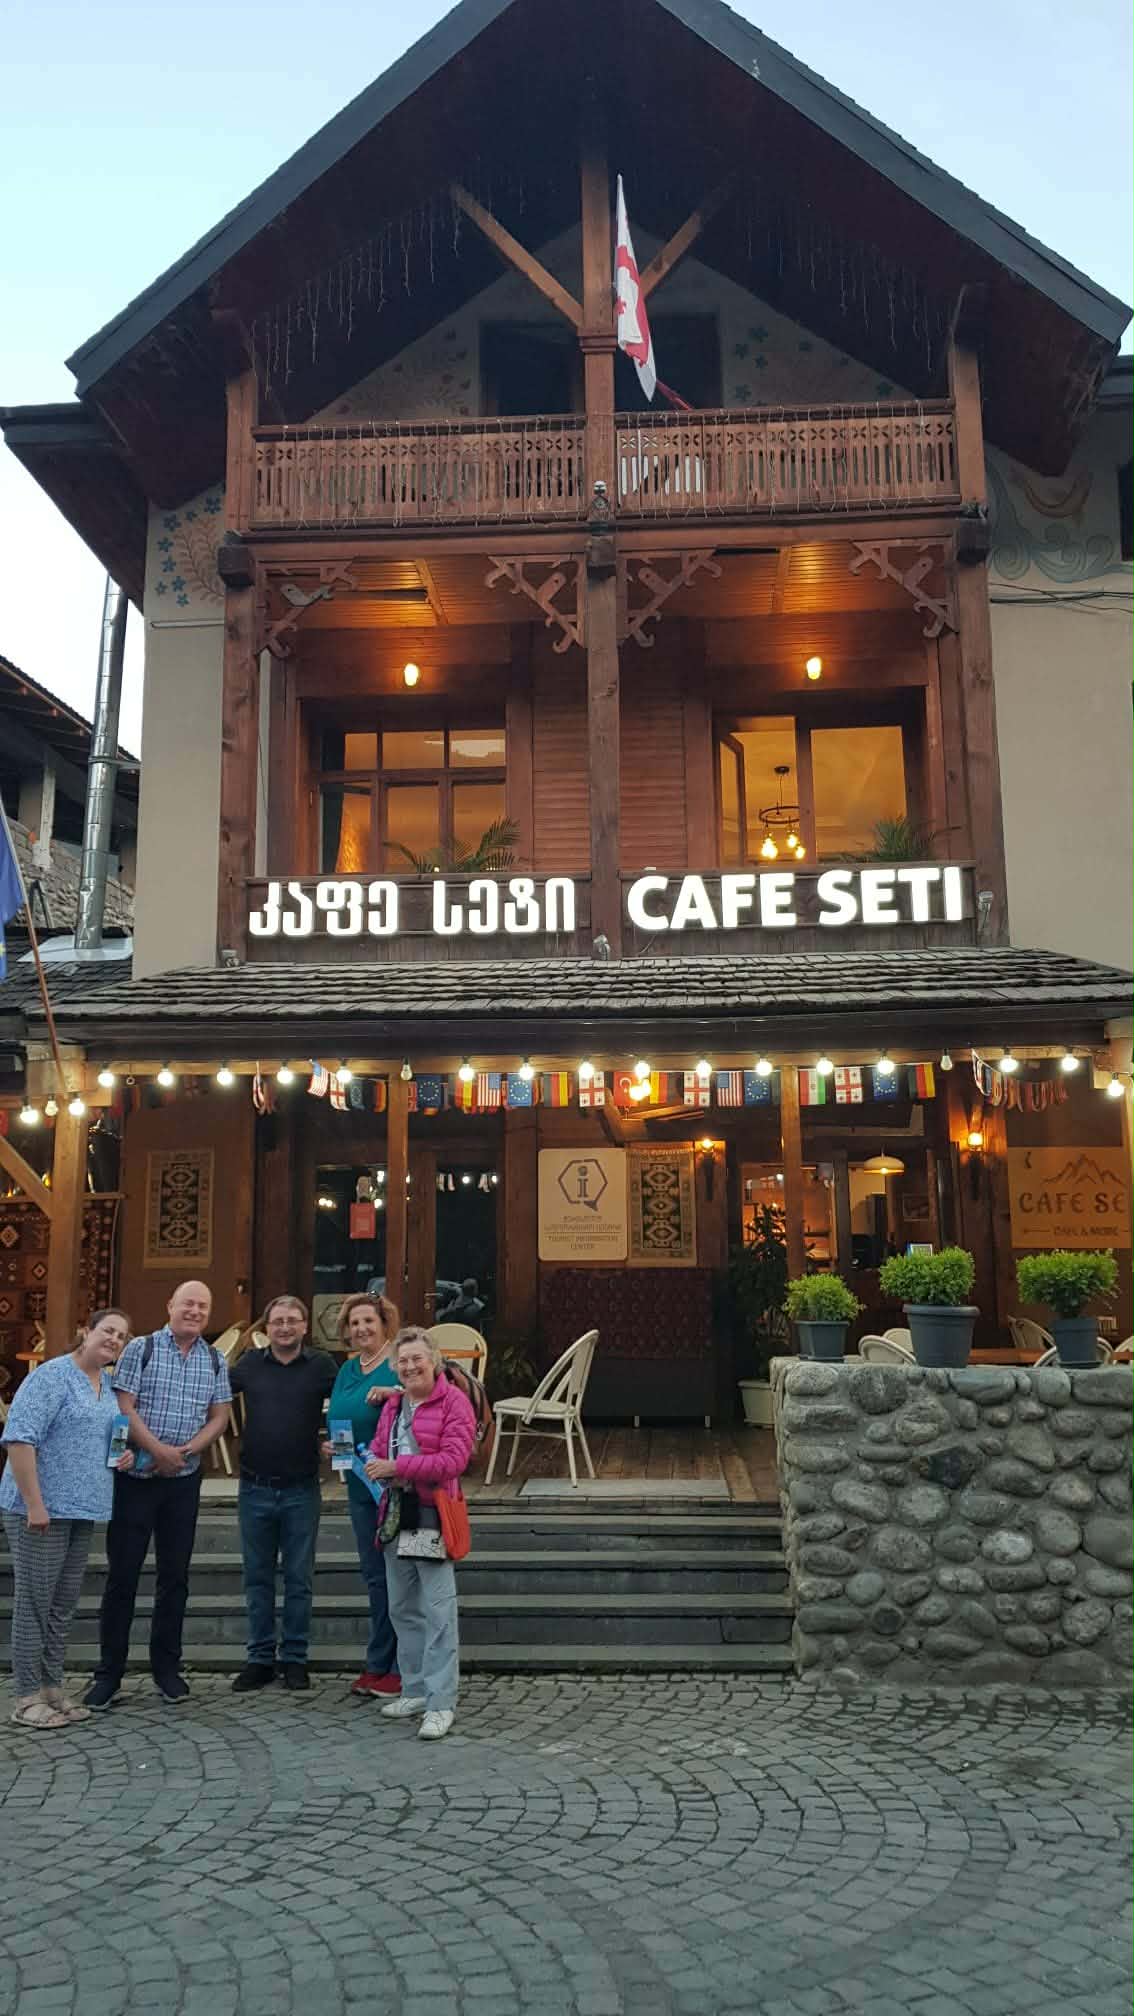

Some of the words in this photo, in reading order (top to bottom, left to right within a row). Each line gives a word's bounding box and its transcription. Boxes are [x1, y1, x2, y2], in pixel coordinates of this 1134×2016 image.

[249, 881, 399, 936] კაფე
[433, 878, 575, 935] სეტი
[627, 873, 797, 930] CAFE
[817, 867, 963, 926] SETI
[1018, 1192, 1084, 1213] CAFE
